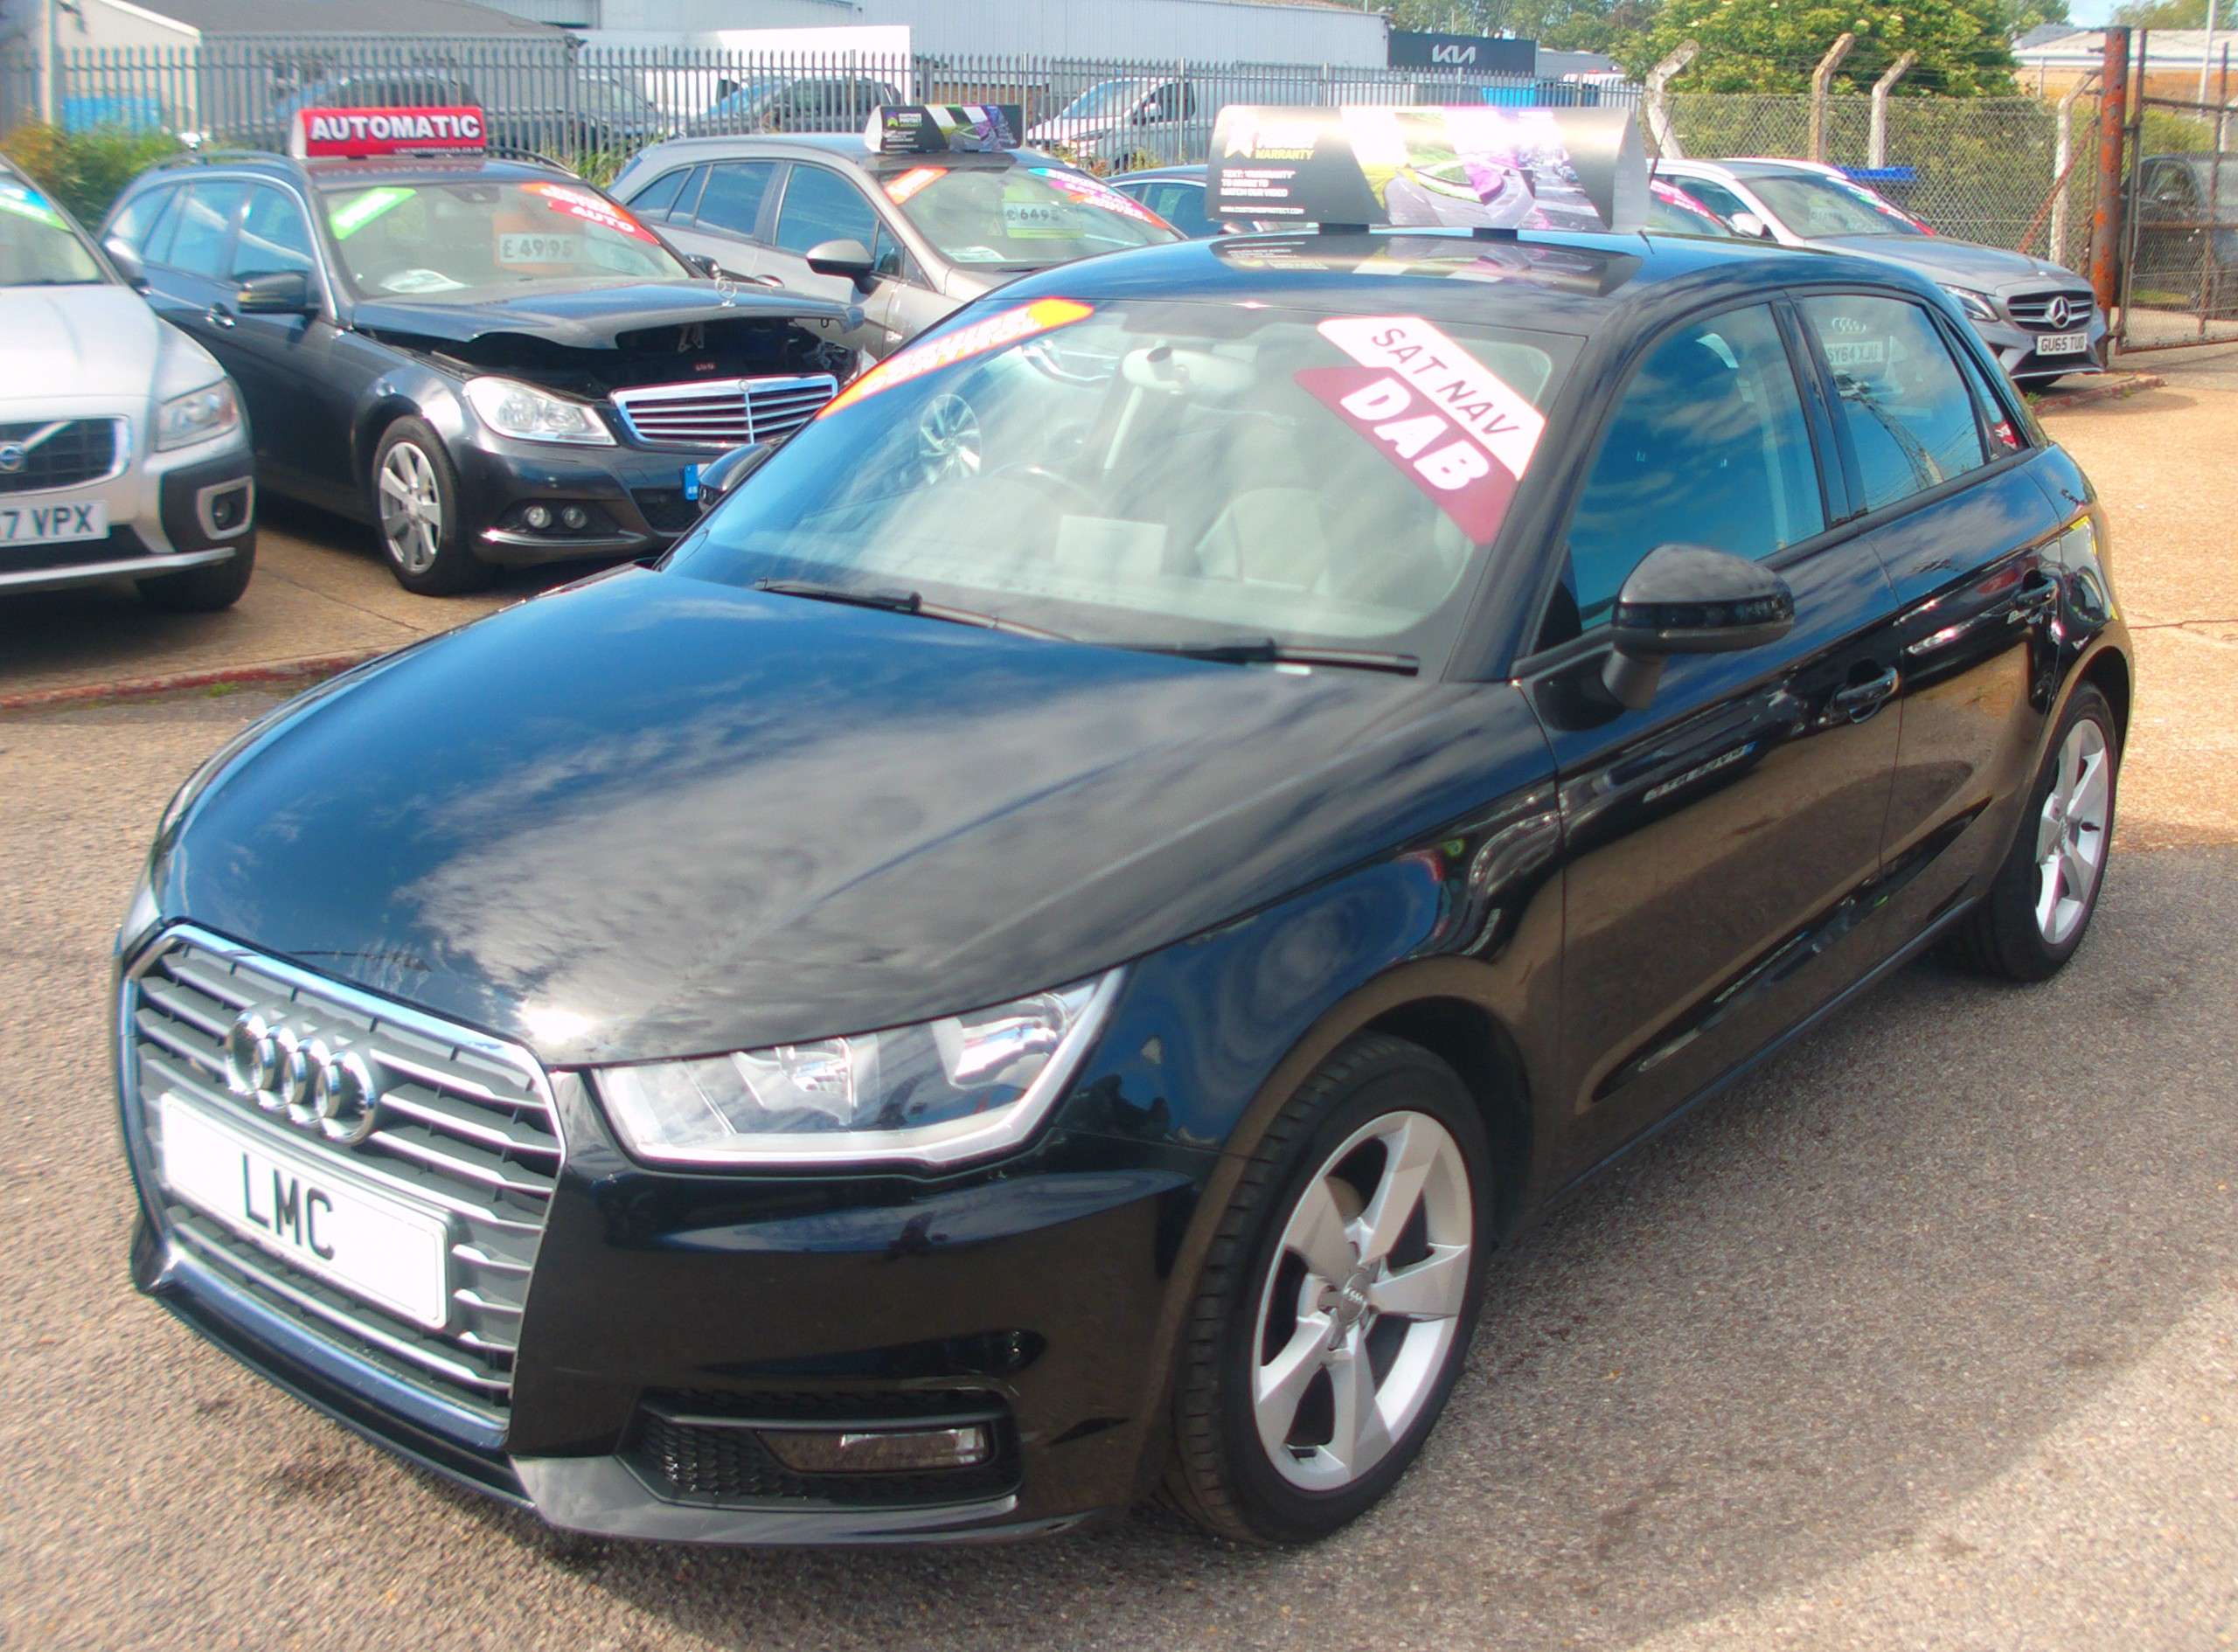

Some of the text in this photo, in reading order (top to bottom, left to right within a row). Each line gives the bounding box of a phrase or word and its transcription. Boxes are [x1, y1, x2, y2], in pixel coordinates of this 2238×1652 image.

[1432, 44, 1477, 65] KIA
[310, 114, 481, 141] AUTOMATIC
[1255, 149, 1315, 160] WARRANTY
[570, 205, 636, 233] AUTO
[2041, 337, 2068, 351] GU65
[1372, 328, 1520, 435] SAT NAV
[1339, 377, 1490, 490] DAB
[31, 504, 94, 537] VPX
[242, 1151, 336, 1261] LMC
